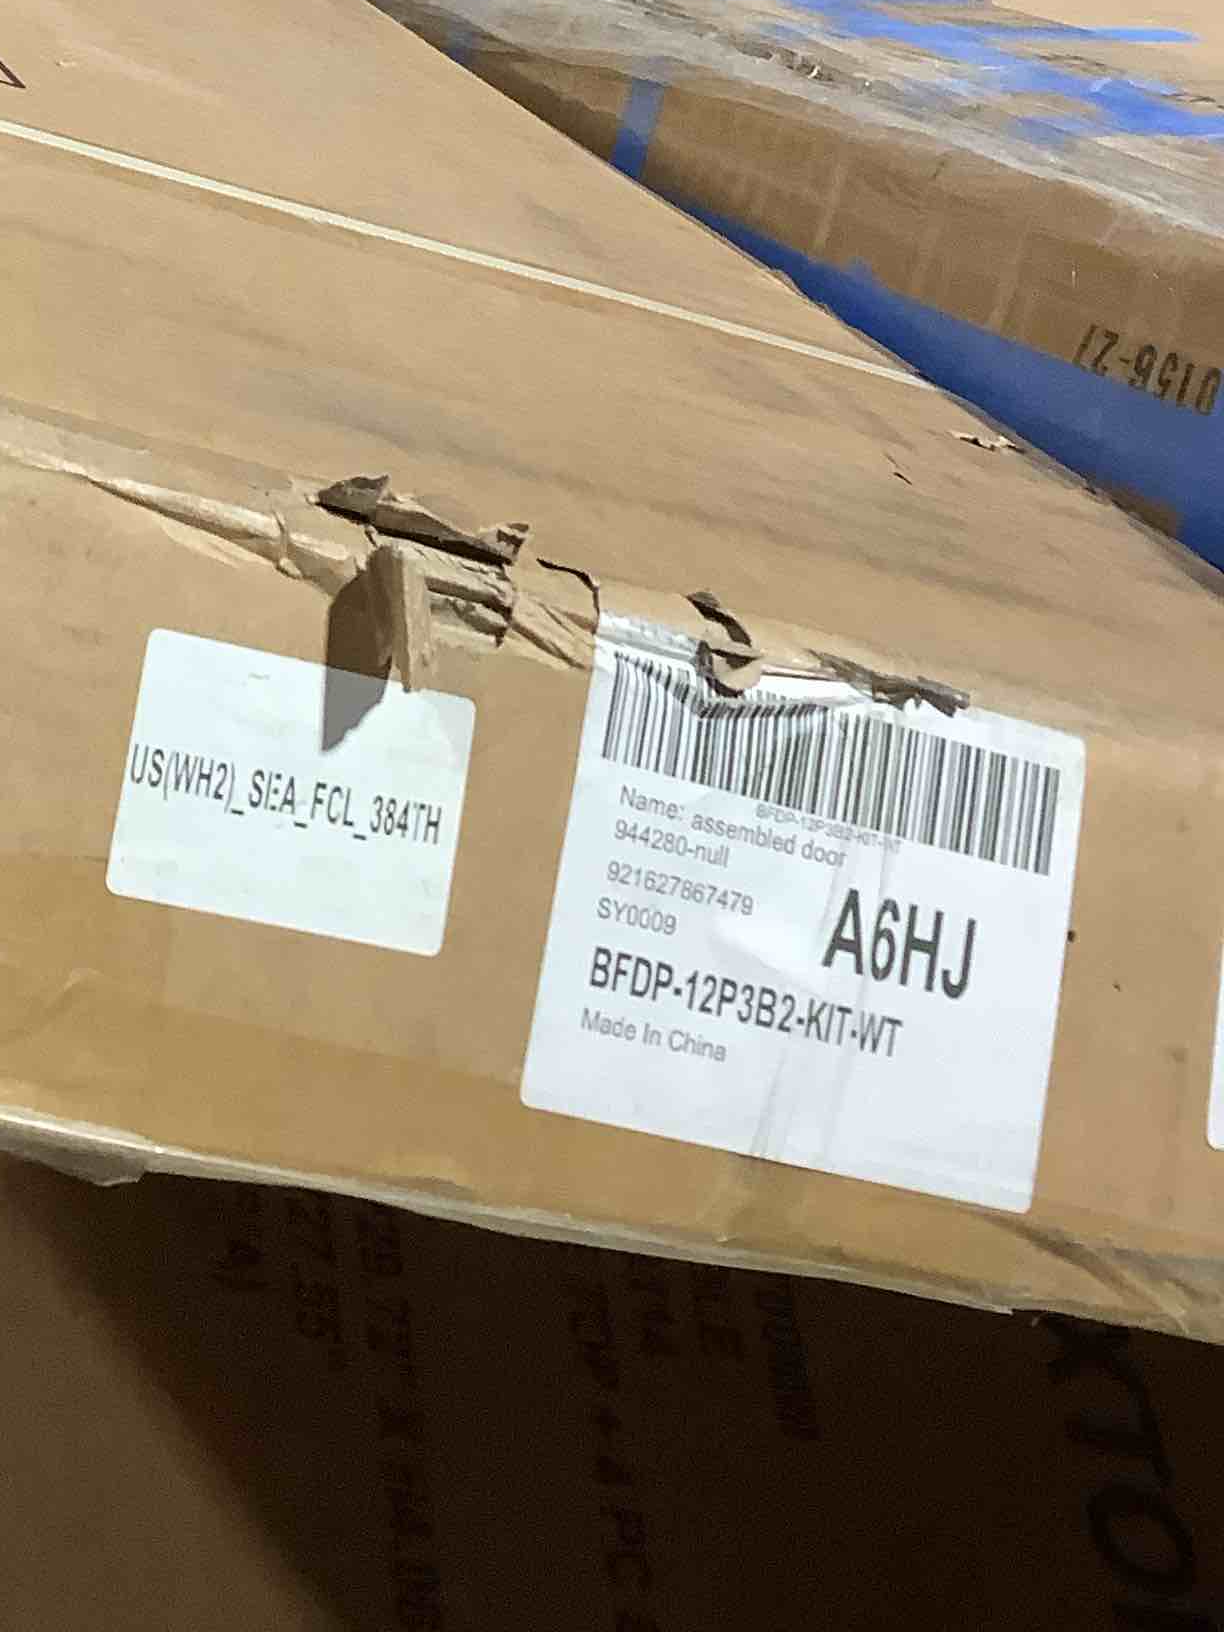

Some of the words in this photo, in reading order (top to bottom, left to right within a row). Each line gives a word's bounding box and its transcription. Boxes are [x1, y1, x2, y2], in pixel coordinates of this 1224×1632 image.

[130, 744, 444, 845] US(WH2)_SEA_FCL_384TH
[620, 784, 684, 821] Name:
[690, 811, 796, 860] assembled
[802, 841, 847, 868] door
[614, 820, 730, 868] 944280-null
[596, 897, 677, 936] SY0009
[607, 861, 755, 917] 921627867479
[823, 887, 978, 1000] A6HJ
[581, 1008, 637, 1043] Made
[643, 1023, 662, 1048] In
[668, 1029, 727, 1063] China
[590, 947, 904, 1058] BFDP-12P3B2-KIT-WT
